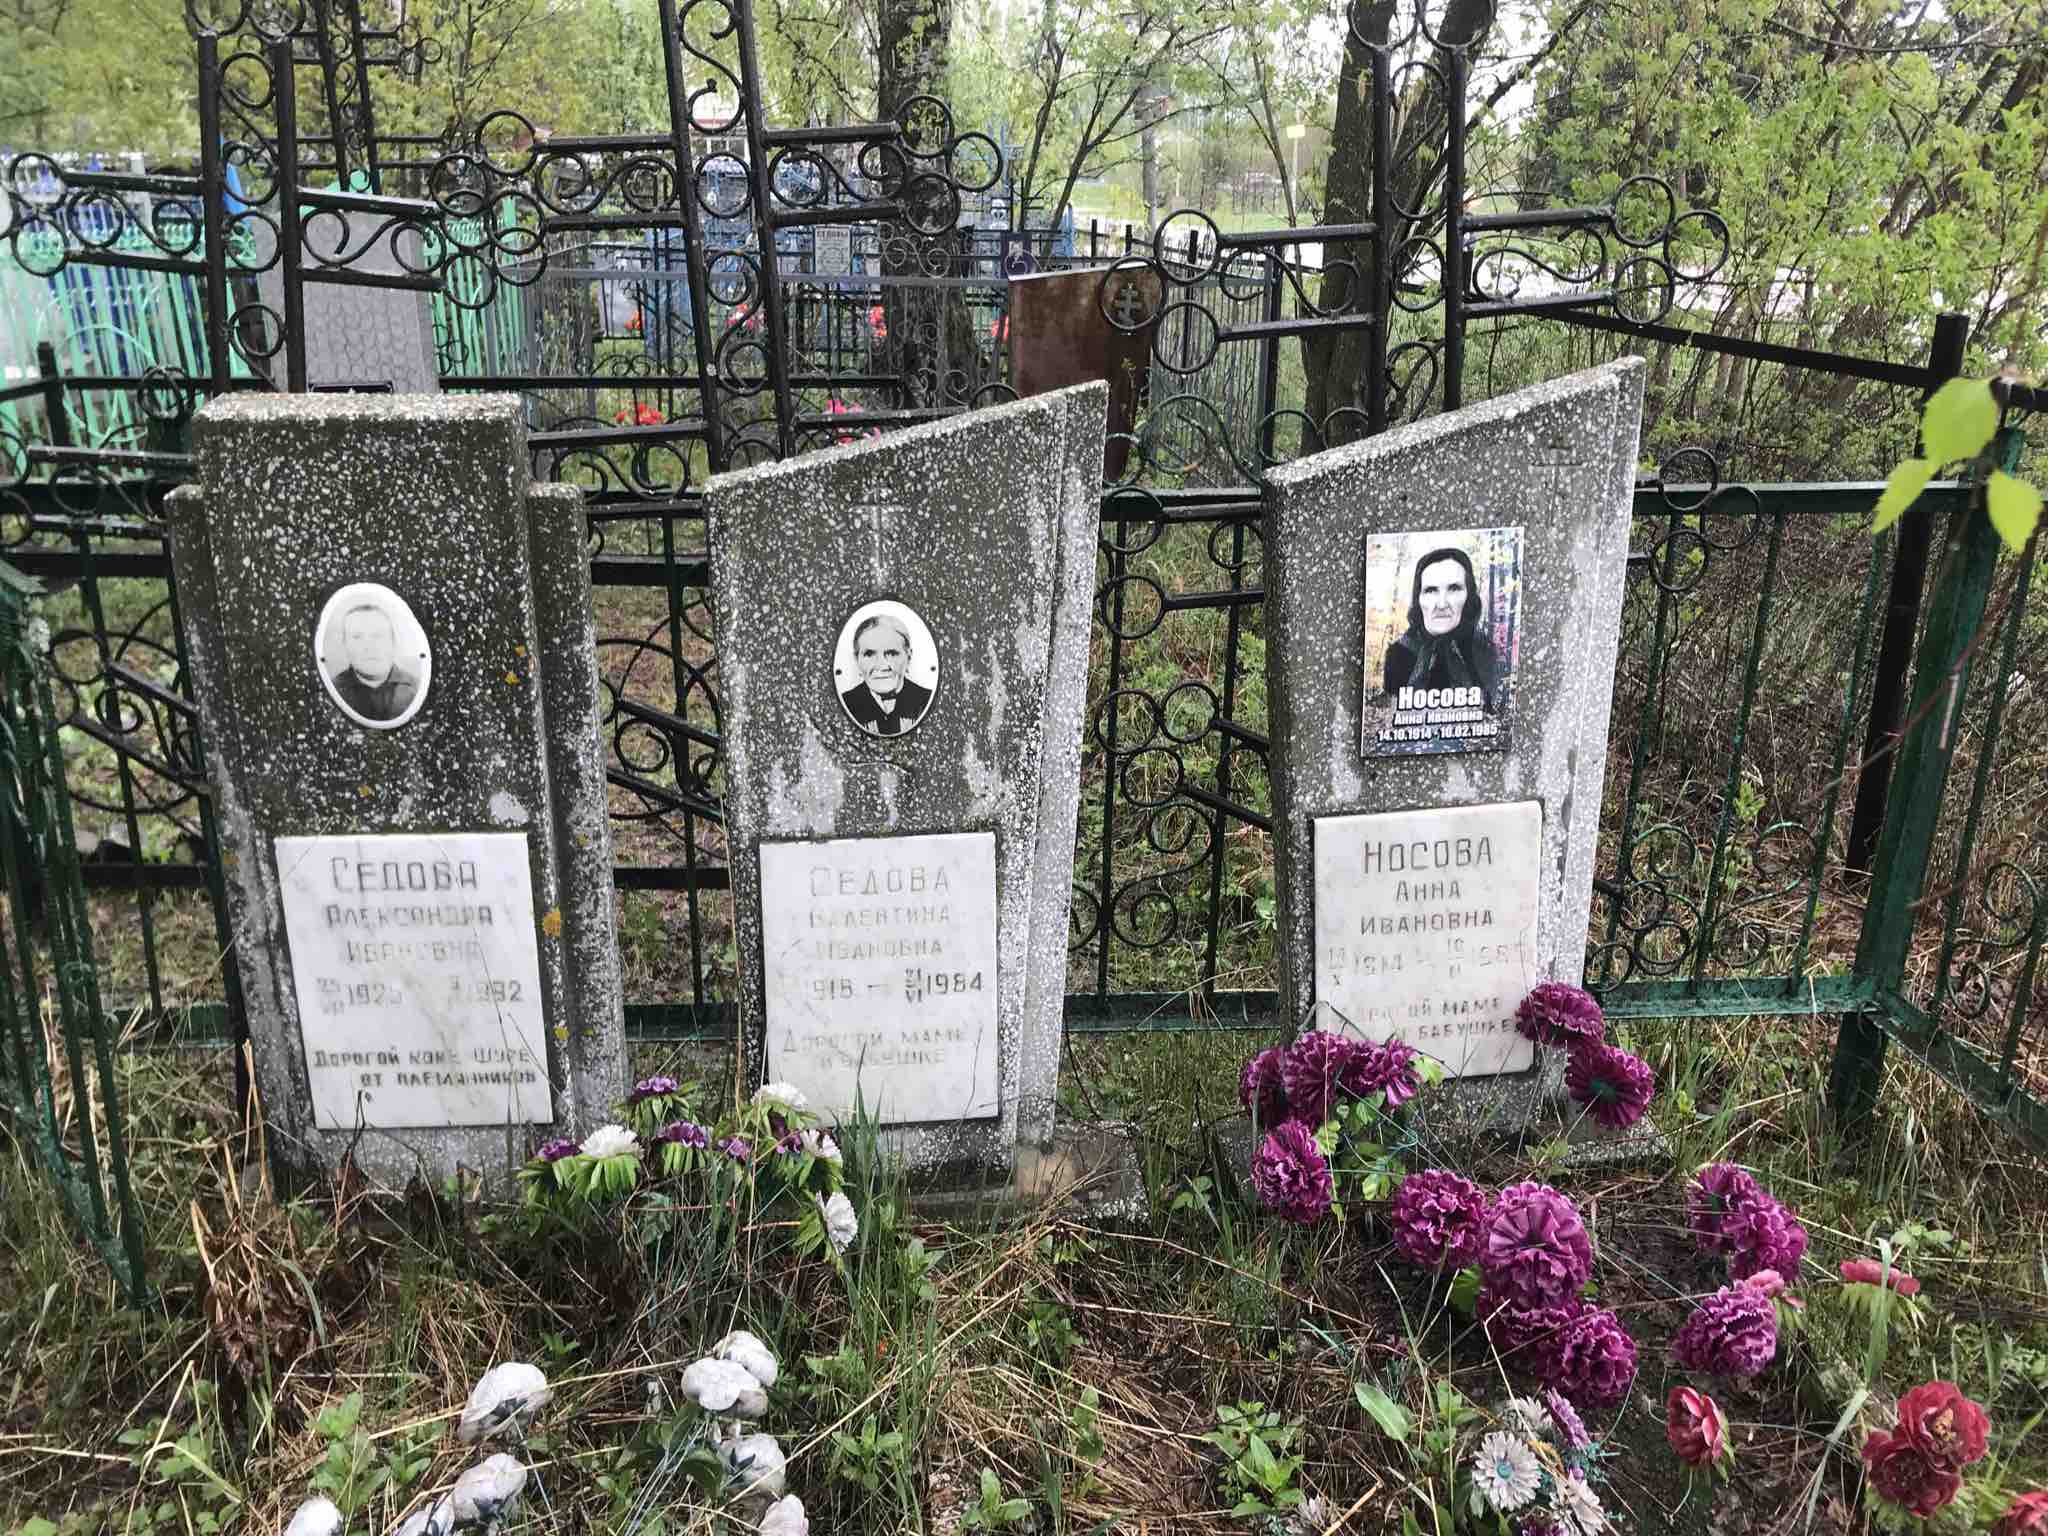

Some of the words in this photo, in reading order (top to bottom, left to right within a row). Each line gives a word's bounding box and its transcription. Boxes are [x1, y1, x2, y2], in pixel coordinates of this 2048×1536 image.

[1398, 686, 1482, 710] Носова
[1394, 711, 1423, 725] Анна
[1363, 837, 1493, 874] НОСОВА
[331, 856, 480, 893] СЕДОВА
[810, 866, 949, 897] СЕДОВА
[1396, 880, 1462, 902] АННА
[1360, 910, 1495, 936] ИВАНОВНА
[926, 970, 983, 996] 1984
